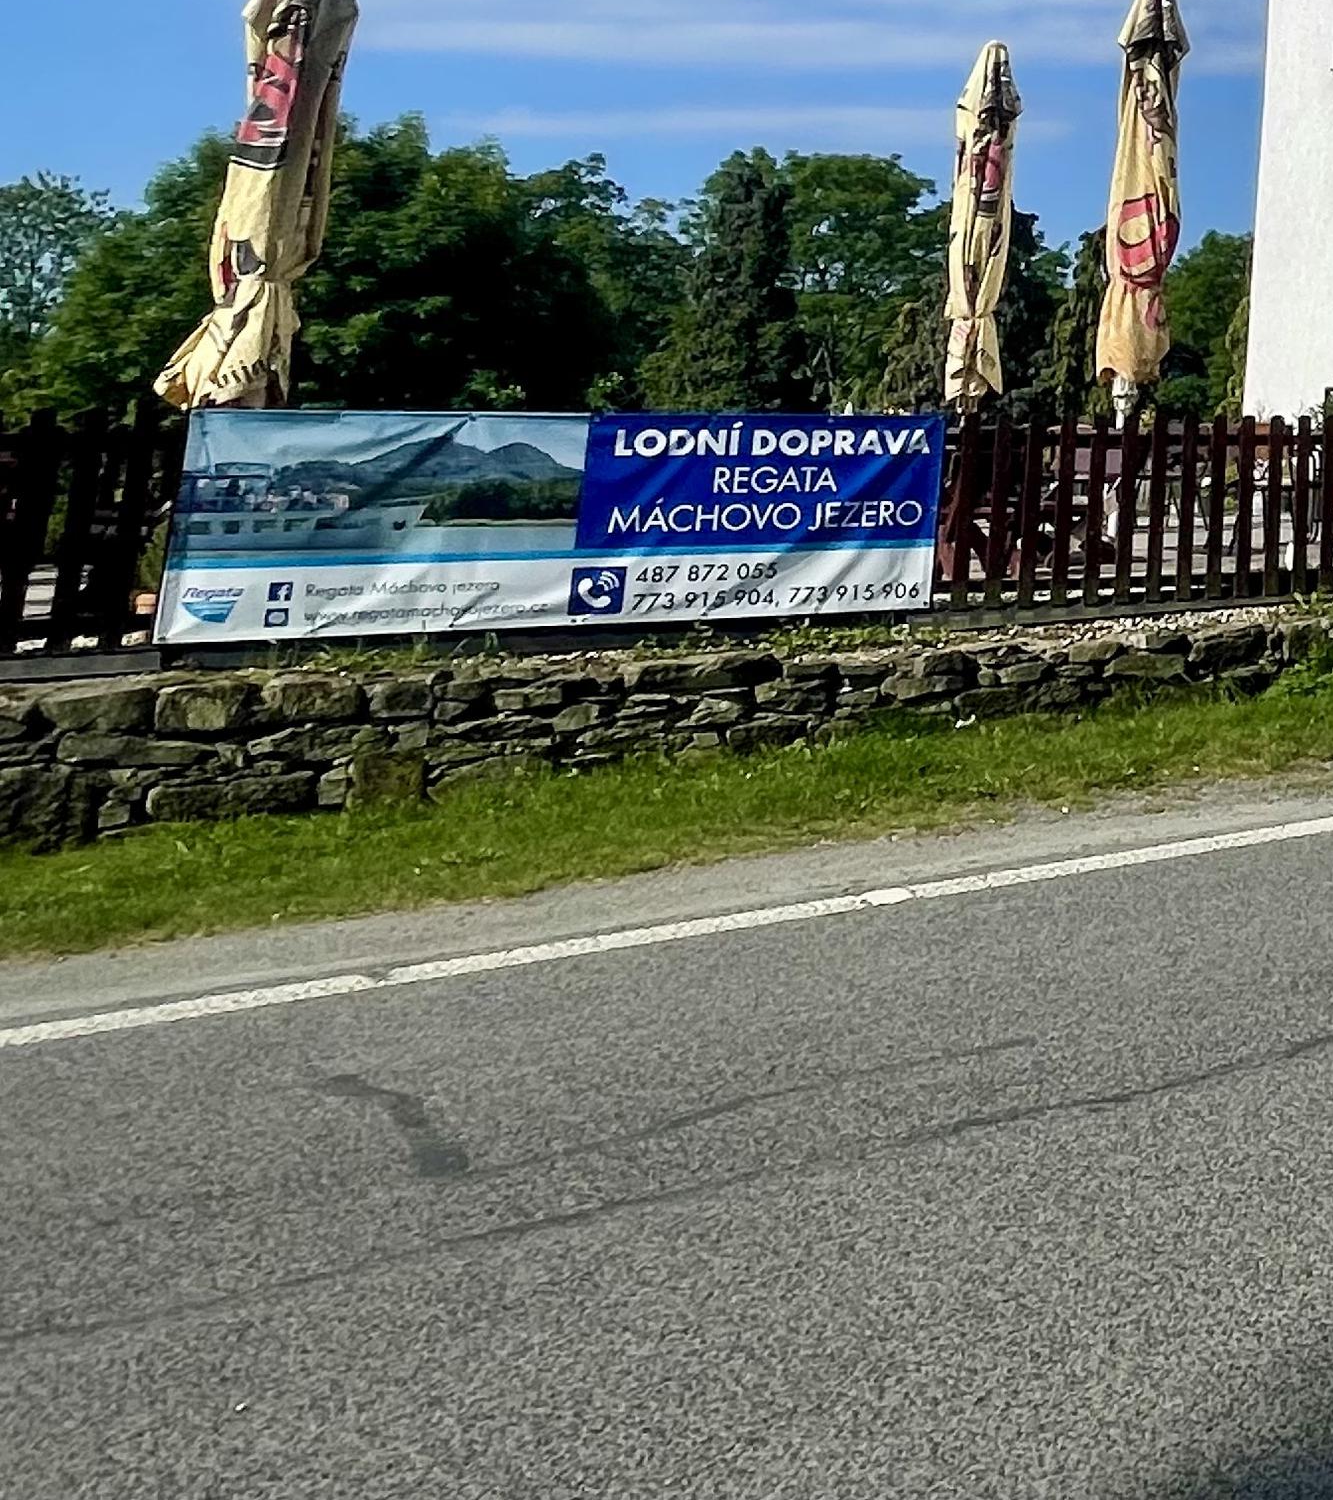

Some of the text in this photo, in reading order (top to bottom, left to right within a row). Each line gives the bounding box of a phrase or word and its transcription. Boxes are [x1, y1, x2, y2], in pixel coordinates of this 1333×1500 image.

[614, 421, 931, 457] LODNÍ DOPRAVA
[713, 466, 838, 494] REGATA
[608, 499, 923, 533] MÁCHOVO JEZERO
[636, 562, 778, 583] 487 872 055
[182, 586, 245, 602] Regata
[305, 584, 364, 600] Regata
[631, 582, 921, 612] 773 915 904, 773 915 906
